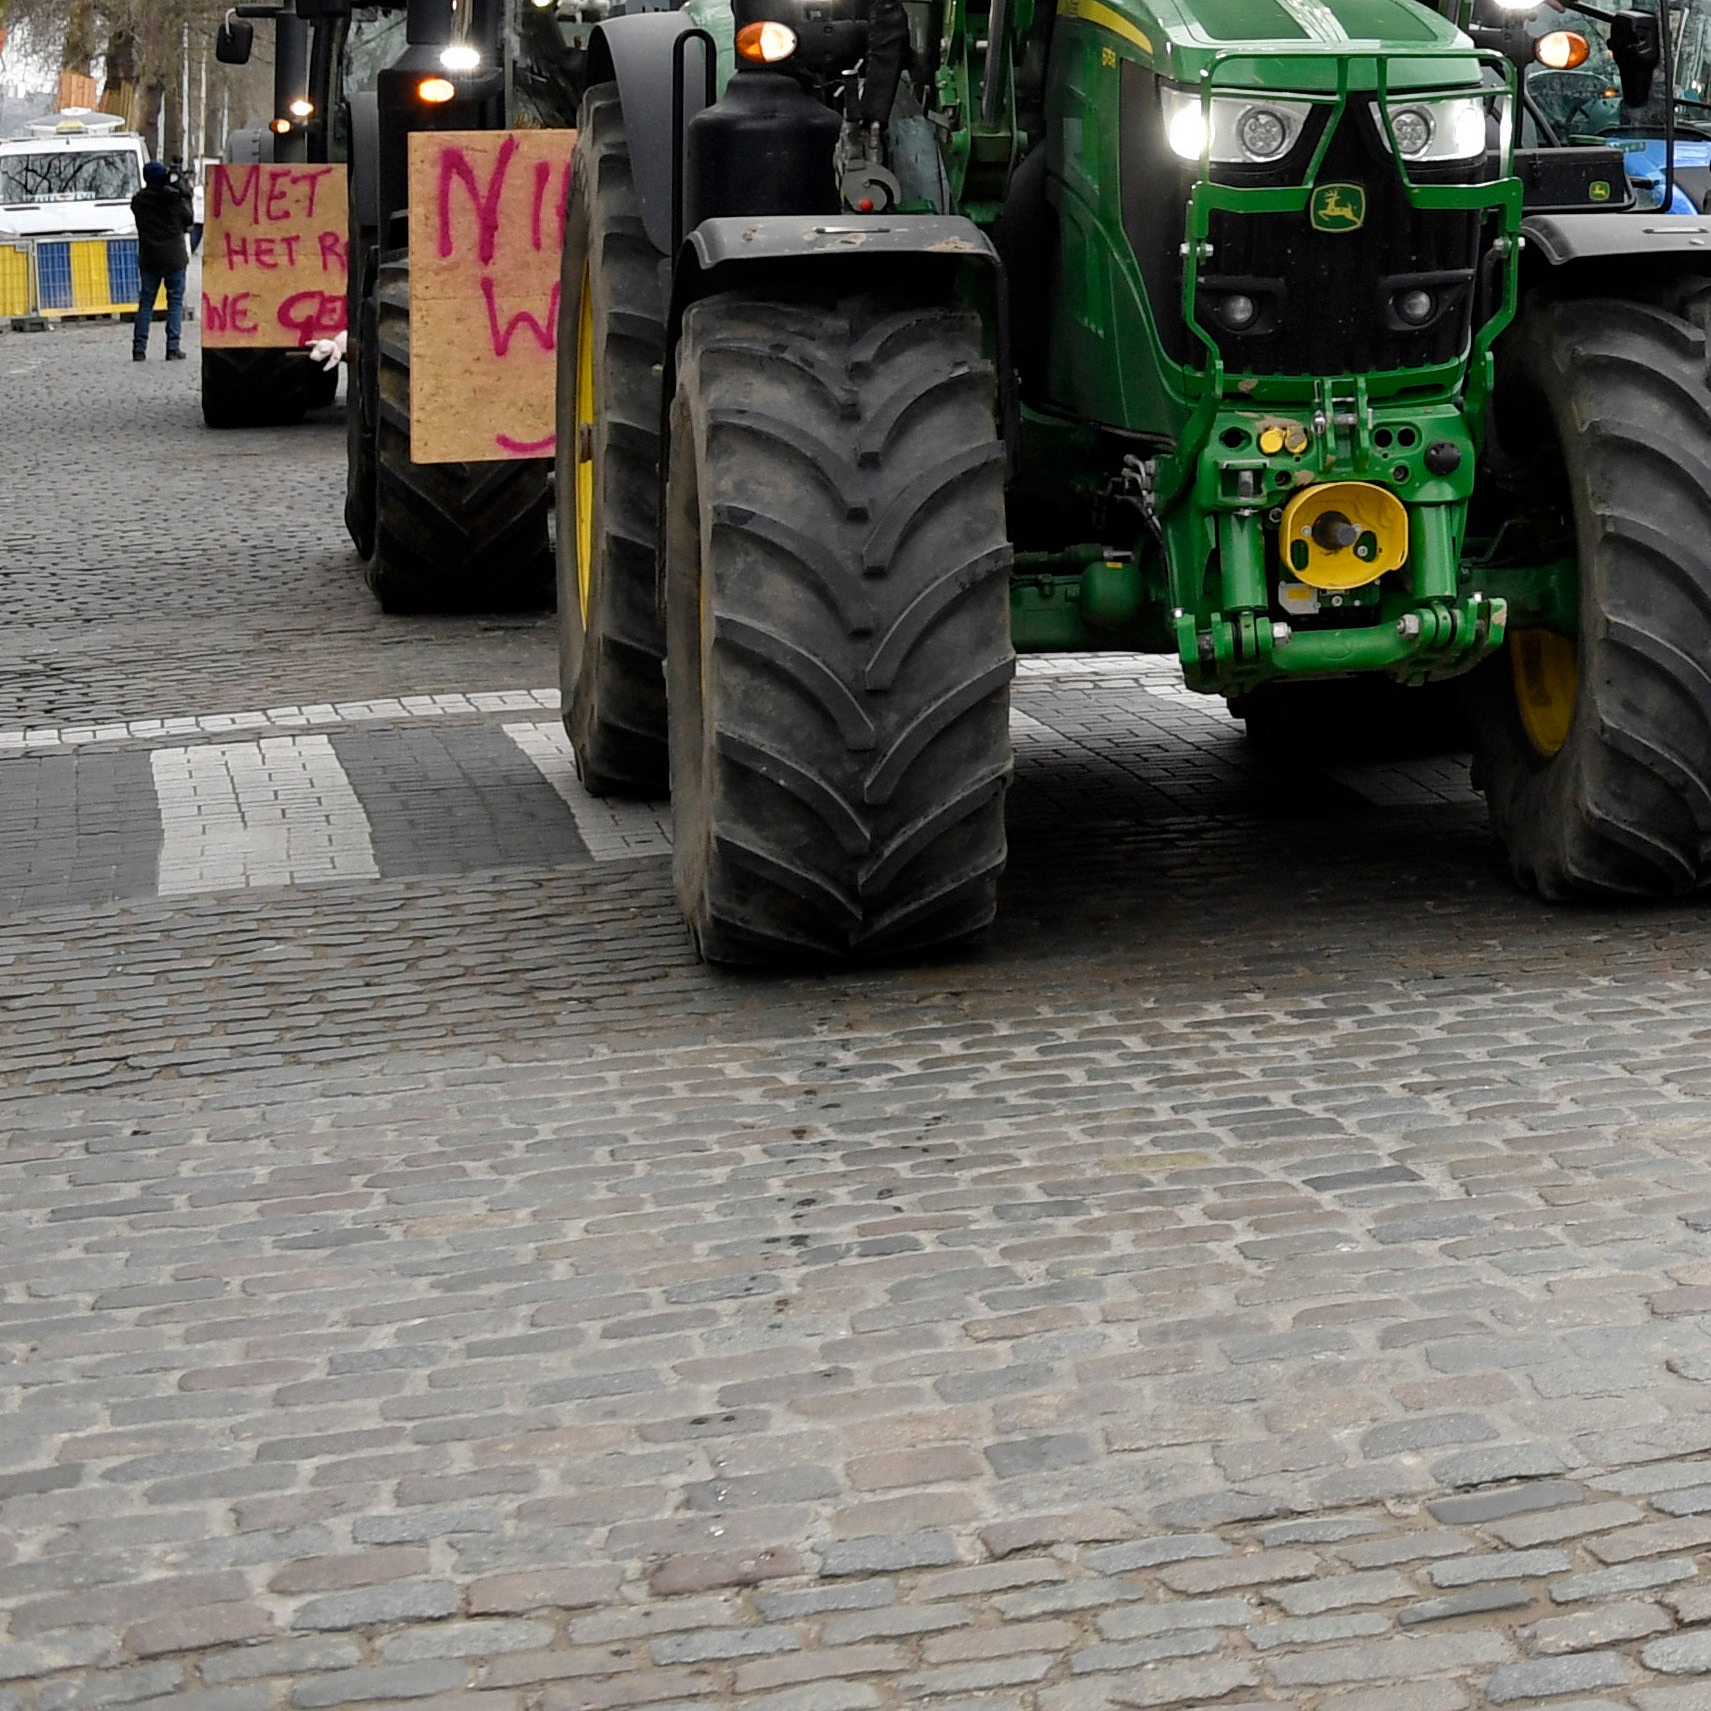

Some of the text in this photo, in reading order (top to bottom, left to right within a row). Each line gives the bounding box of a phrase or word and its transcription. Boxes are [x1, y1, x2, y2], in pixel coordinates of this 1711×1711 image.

[213, 164, 333, 225] MET
[437, 136, 571, 266] NI
[224, 231, 349, 273] HET R
[201, 291, 258, 333] WE
